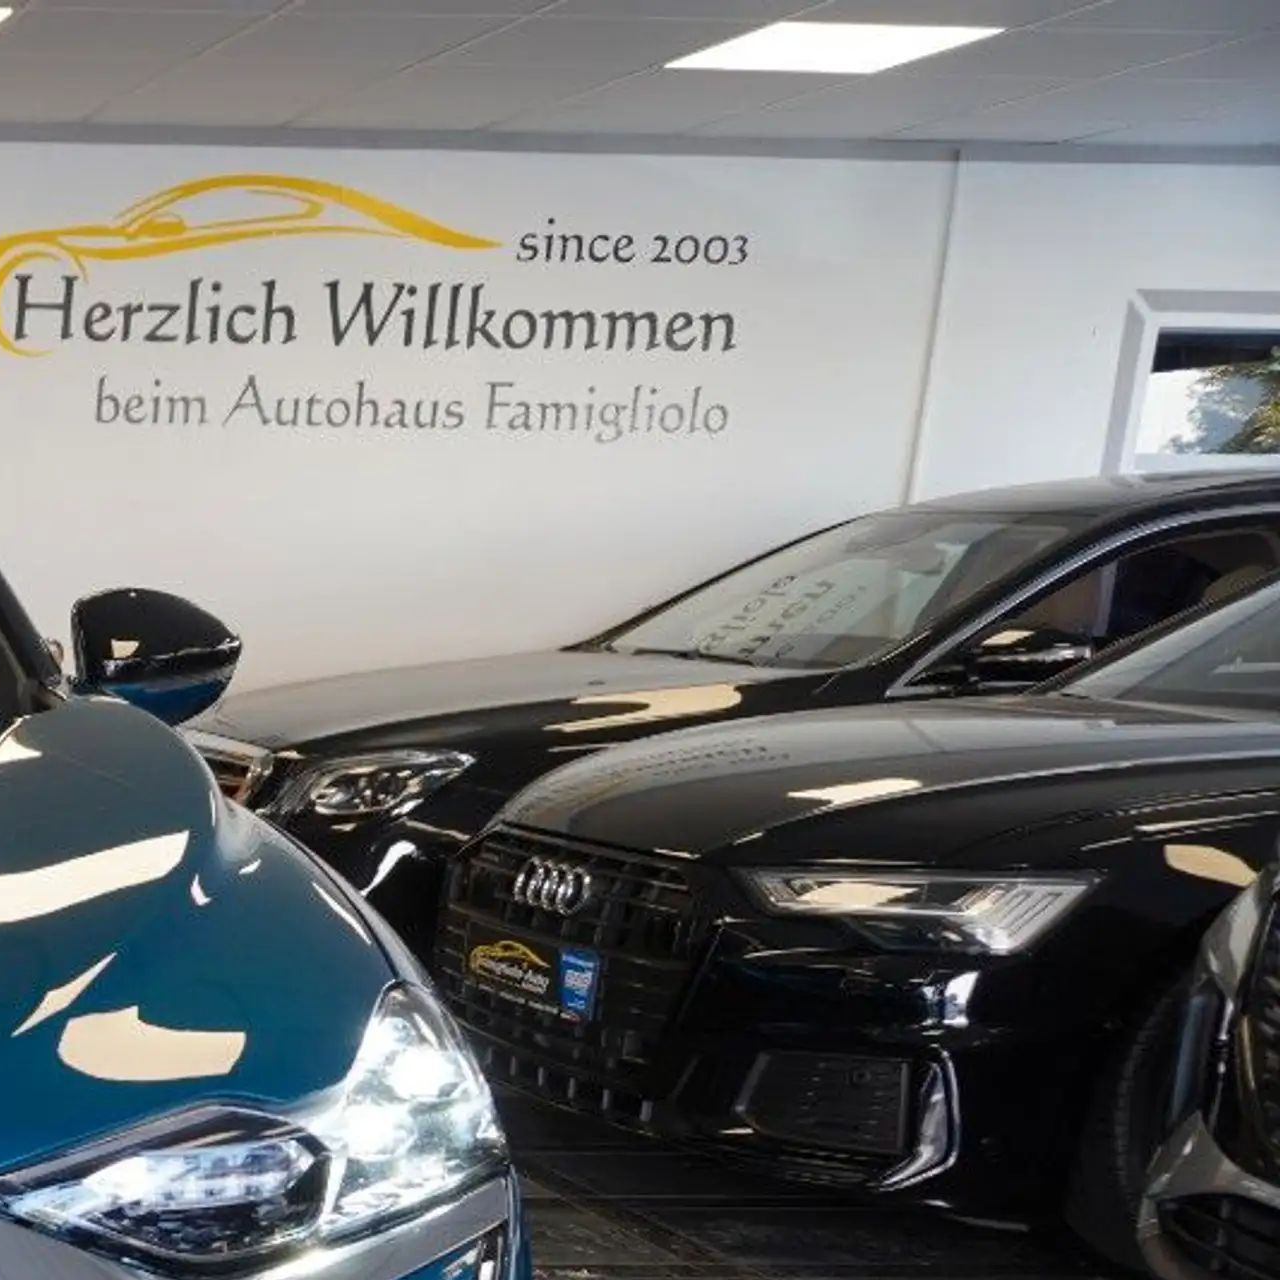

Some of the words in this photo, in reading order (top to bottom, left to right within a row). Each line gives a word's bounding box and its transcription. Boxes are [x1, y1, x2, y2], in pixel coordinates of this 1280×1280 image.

[516, 217, 636, 264] since
[651, 234, 749, 266] 2003
[13, 273, 297, 345] Herzlich
[325, 279, 738, 352] Willkommen
[95, 375, 208, 425] beim
[222, 374, 466, 430] Autohaus
[485, 381, 729, 443] Famigliolo
